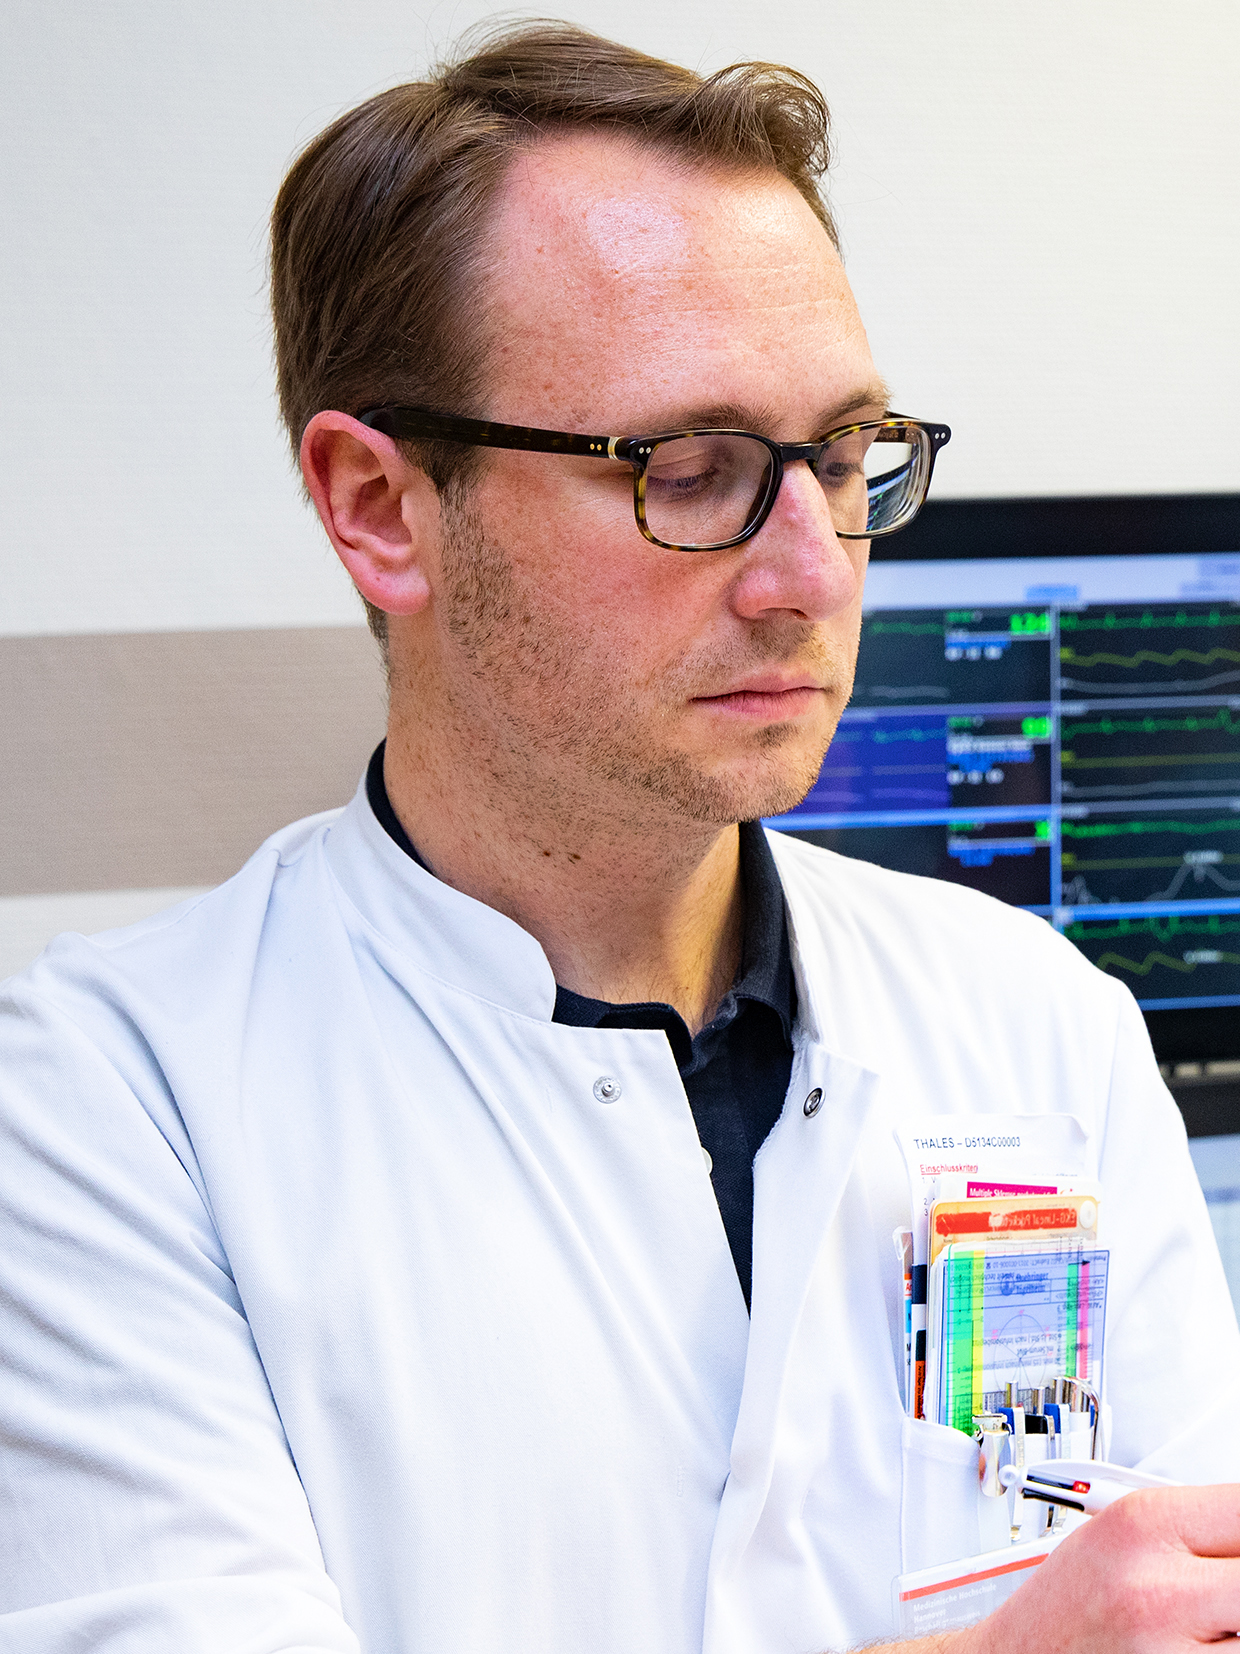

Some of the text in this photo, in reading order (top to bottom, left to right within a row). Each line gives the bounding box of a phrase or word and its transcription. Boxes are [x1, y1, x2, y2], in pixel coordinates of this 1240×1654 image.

[913, 1137, 955, 1149] THALES
[913, 1583, 997, 1612] Medizinische Hochschule
[913, 1608, 947, 1624] Hannover
